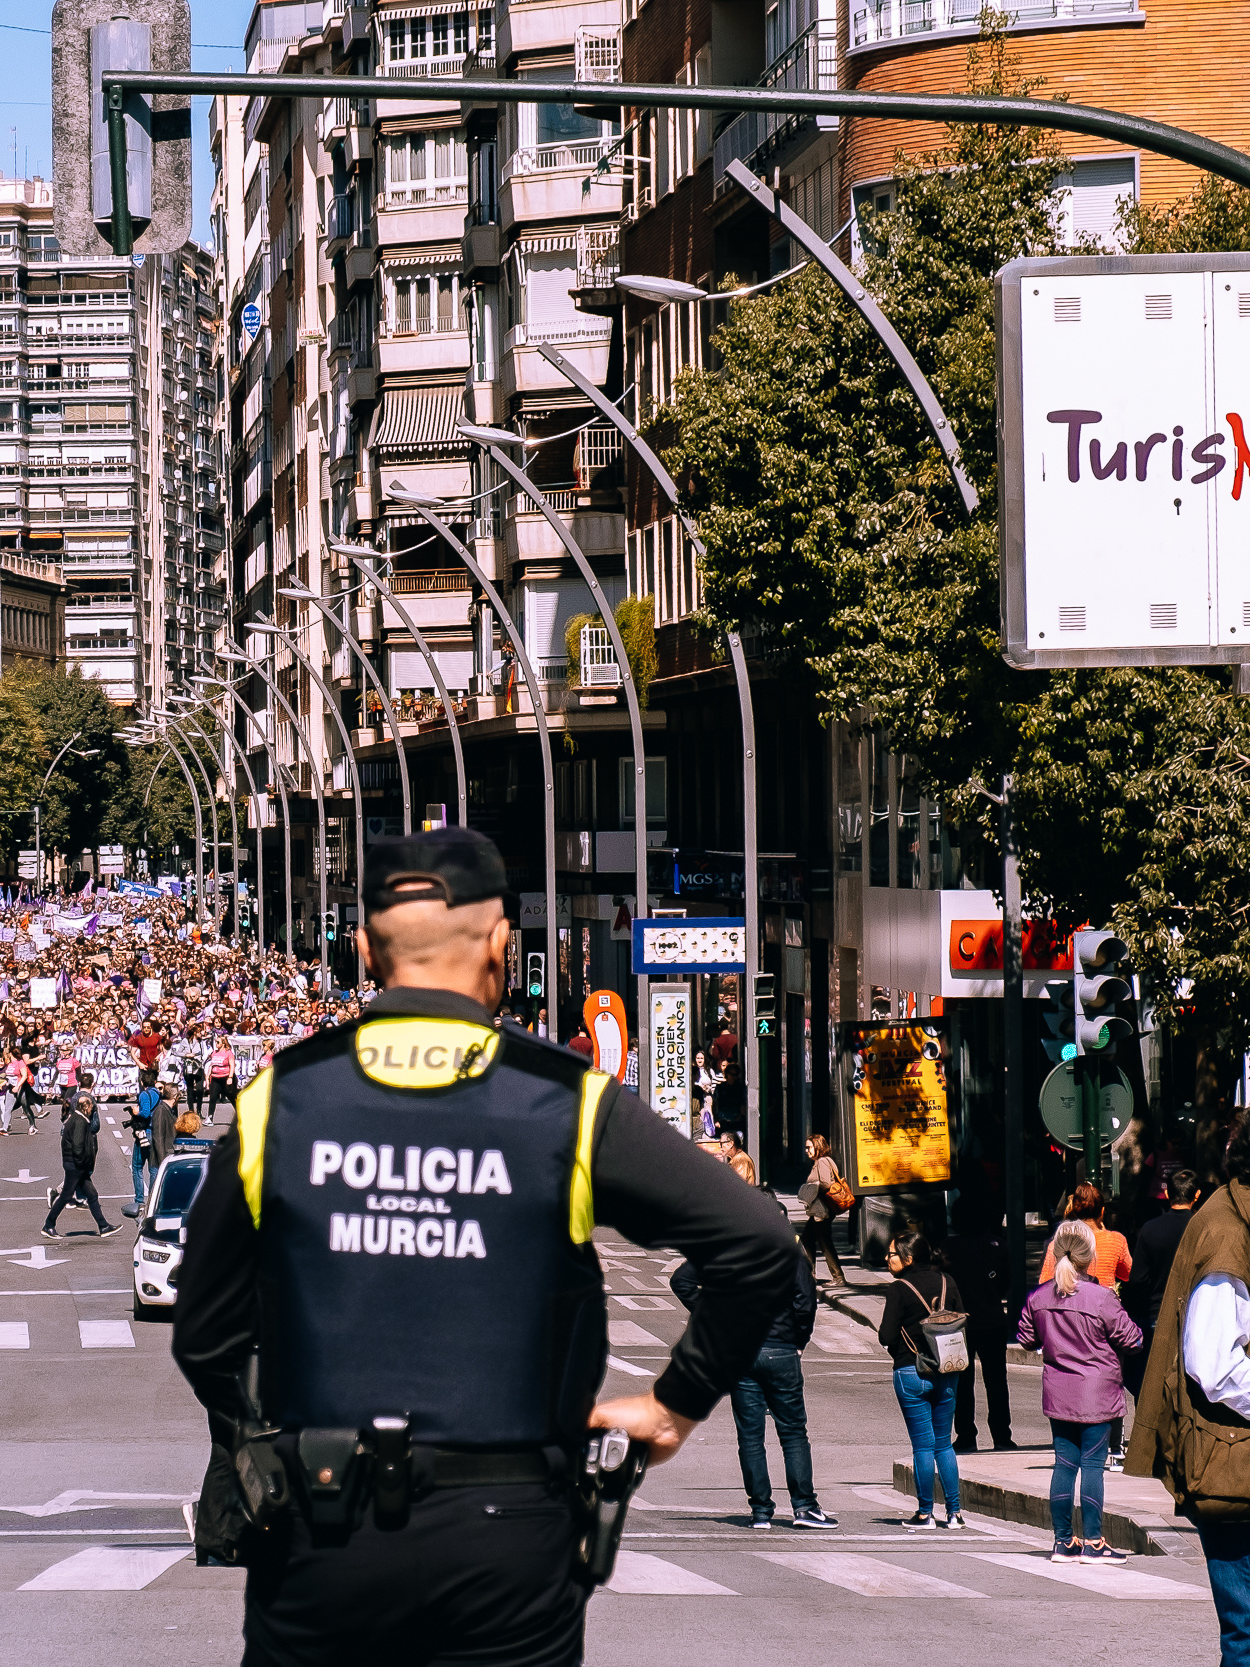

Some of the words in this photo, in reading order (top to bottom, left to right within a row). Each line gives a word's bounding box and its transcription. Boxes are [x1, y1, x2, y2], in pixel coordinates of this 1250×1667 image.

[680, 873, 713, 885] MGS
[657, 1026, 665, 1059] CIEN
[676, 1000, 685, 1088] MURCIANOS
[657, 1063, 665, 1088] LAT
[667, 1057, 675, 1088] POR
[309, 1140, 512, 1195] POLICIA
[366, 1195, 451, 1213] LOCAL
[329, 1213, 487, 1259] MURCIA
